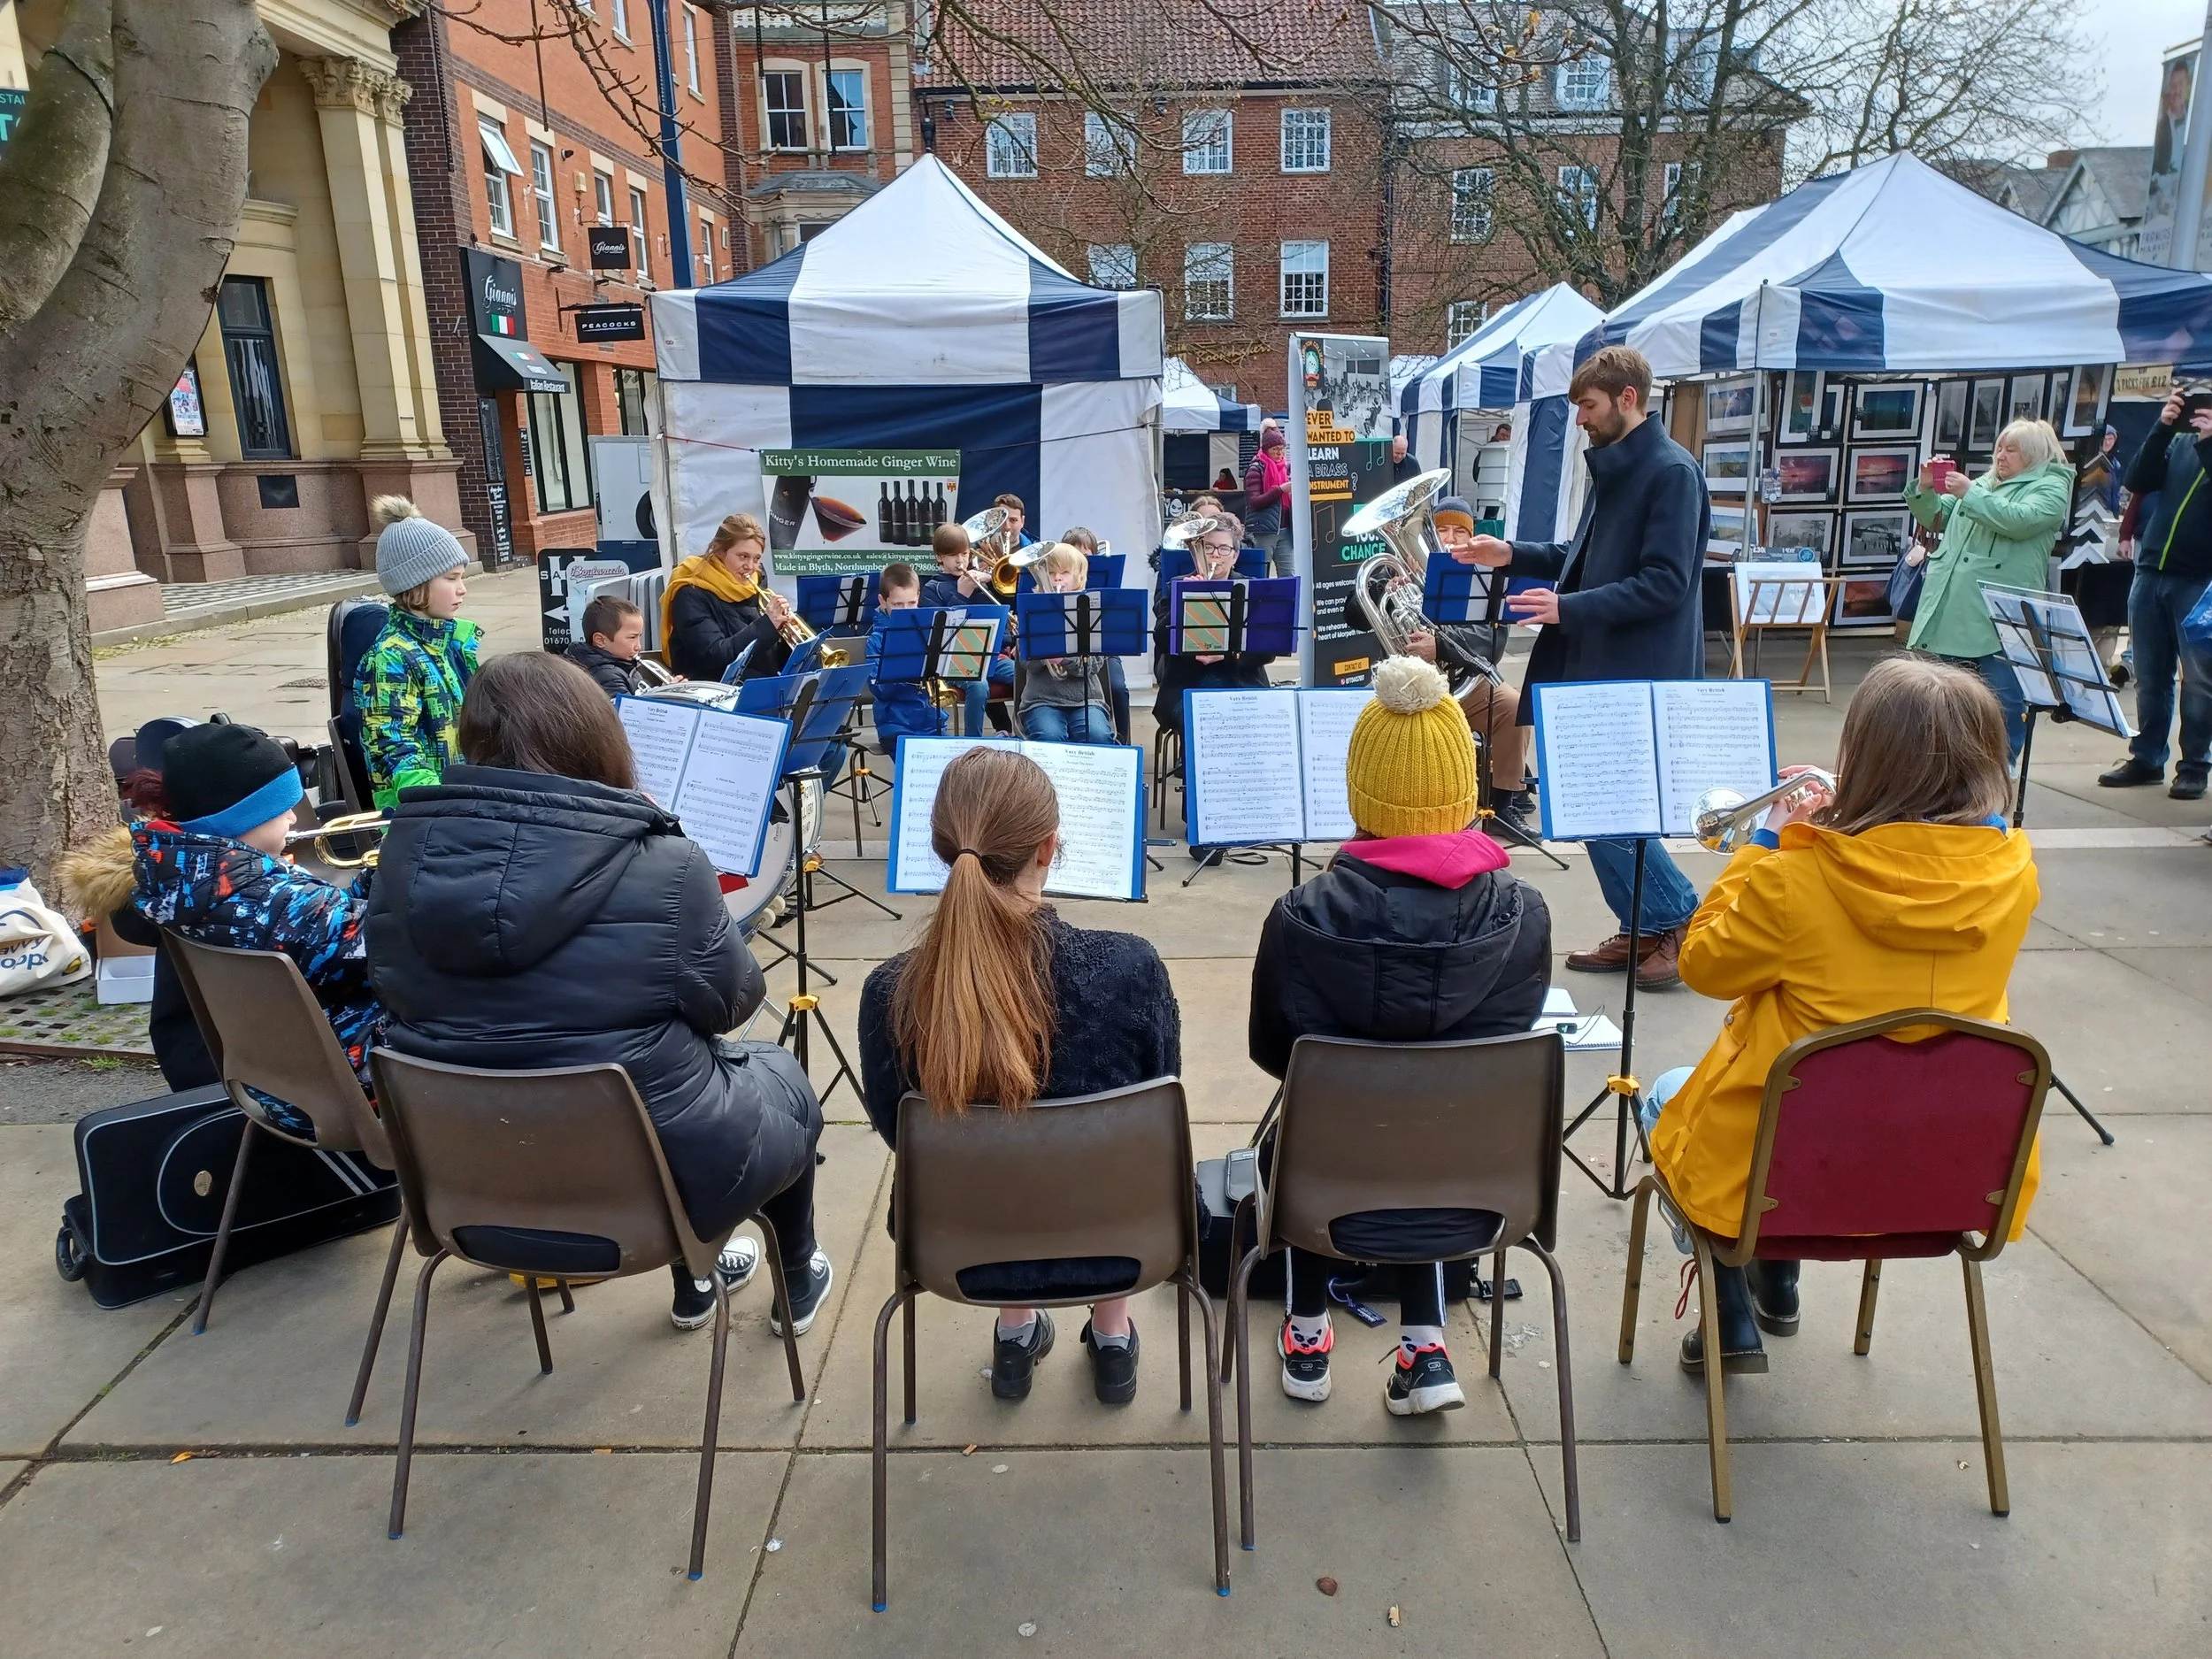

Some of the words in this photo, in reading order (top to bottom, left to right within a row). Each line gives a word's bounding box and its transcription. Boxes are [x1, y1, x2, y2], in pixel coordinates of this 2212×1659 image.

[592, 242, 626, 256] Giannis
[483, 275, 518, 309] Giannis
[1307, 412, 1331, 425] EVER
[1307, 431, 1342, 442] WANTED
[1344, 430, 1356, 442] TO
[1308, 447, 1340, 460] LEARN
[764, 455, 804, 470] Kitty's
[807, 455, 878, 467] Homemade
[881, 456, 923, 471] Ginger
[926, 457, 956, 468] Wine
[1315, 463, 1348, 477] BRASS
[1310, 480, 1349, 490] NSTRUMENT
[774, 552, 862, 561] www.kittysgingerwine.co.uk
[866, 552, 936, 561] sales@kittysgingerwin
[1341, 542, 1386, 562] CHANCE
[809, 563, 833, 572] Blyth,
